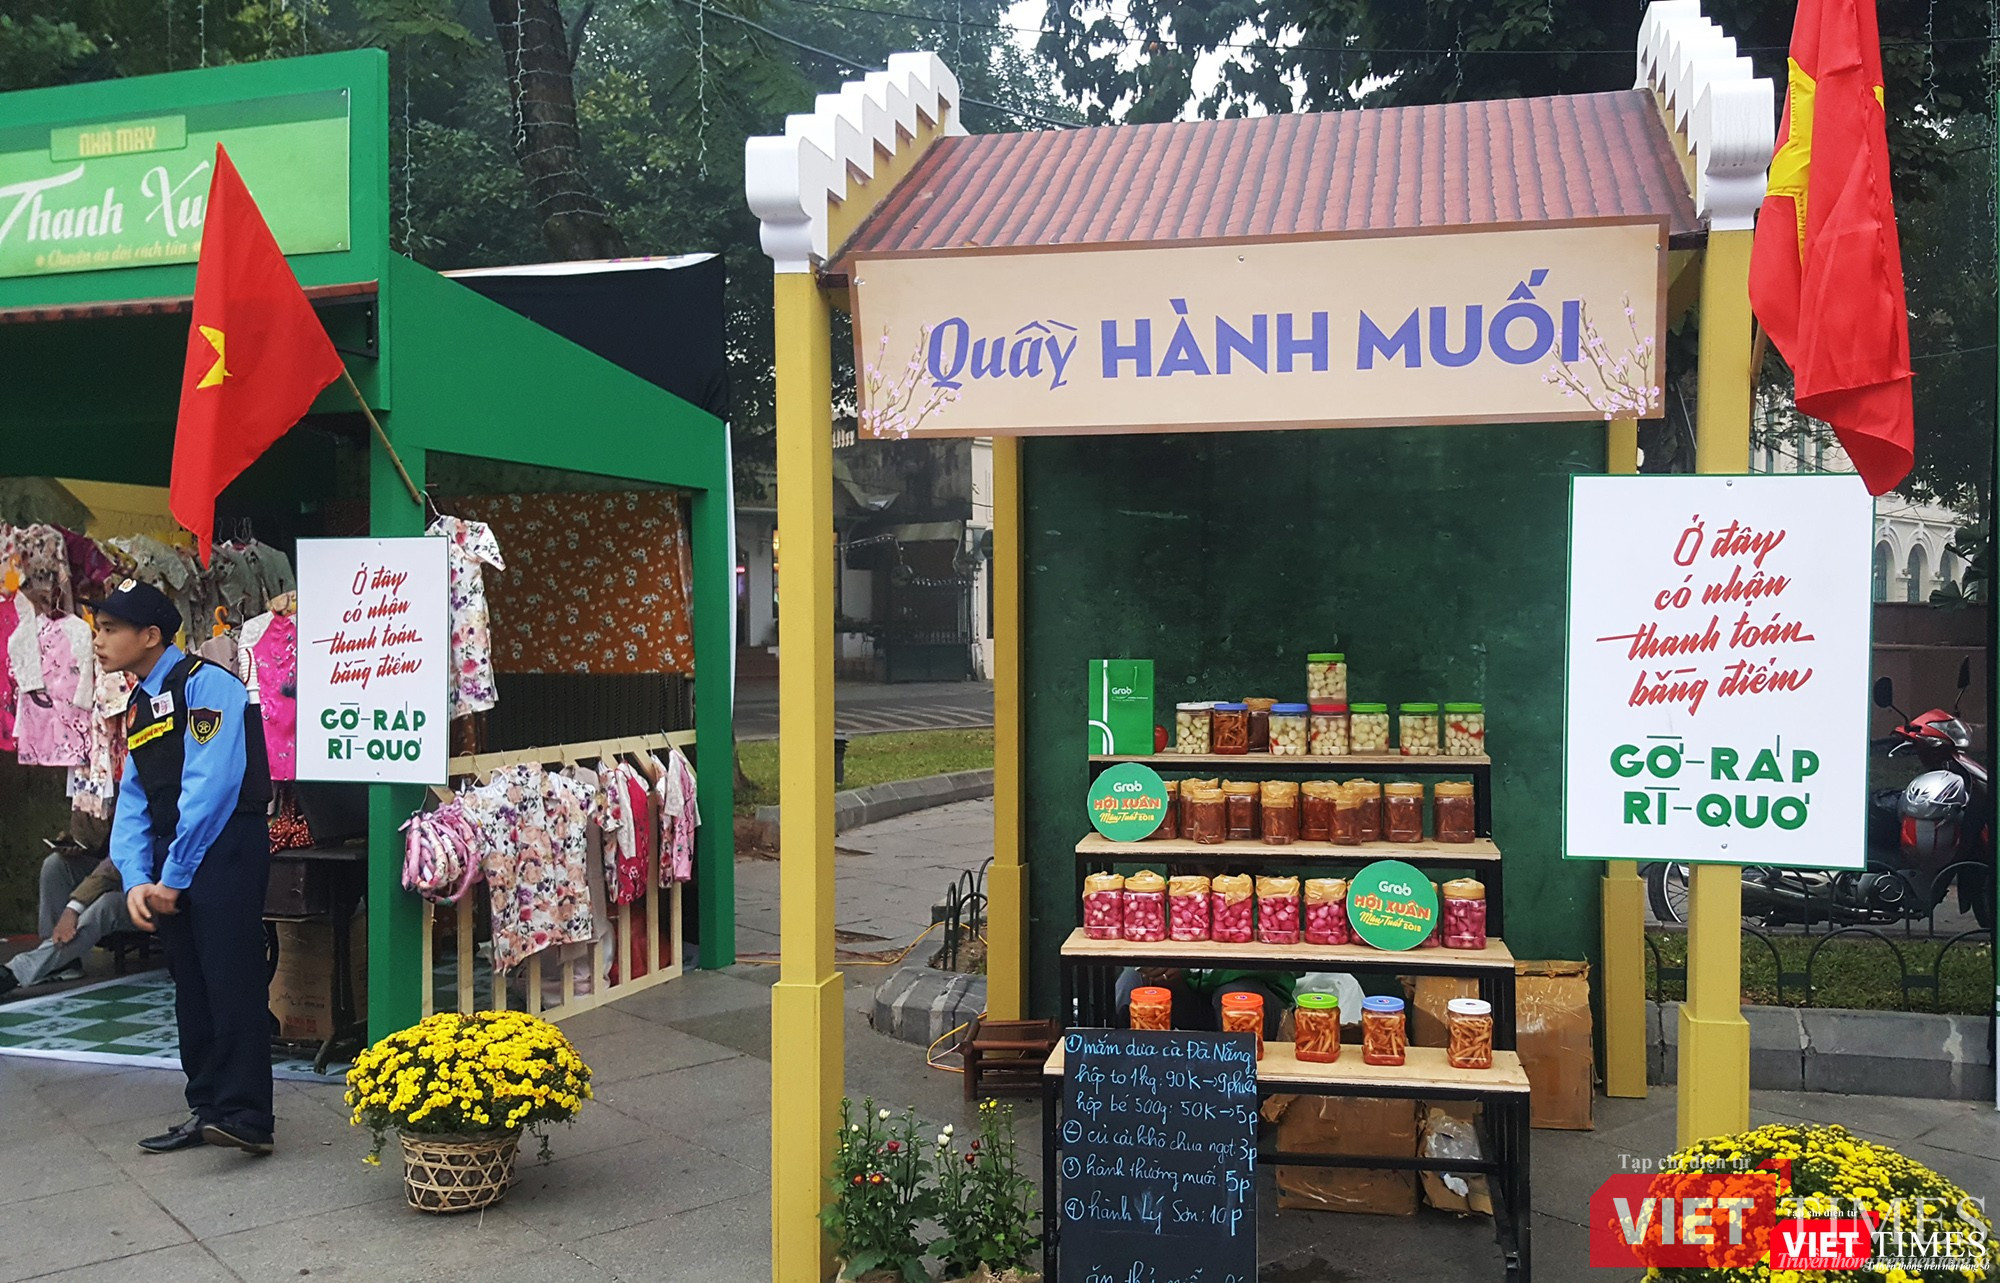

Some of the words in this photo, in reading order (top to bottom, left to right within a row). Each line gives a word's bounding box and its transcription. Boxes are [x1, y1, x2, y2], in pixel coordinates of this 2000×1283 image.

[0, 163, 124, 245] Thanh
[141, 160, 209, 237] Xu
[928, 317, 1078, 391] Quầy
[1101, 298, 1329, 378] HÀNH
[1357, 269, 1580, 370] MUỐI
[1673, 514, 1704, 567] Ở
[1711, 520, 1786, 569] đây
[352, 562, 368, 596] Ở
[371, 566, 408, 596] đây
[1654, 574, 1694, 611] có
[1701, 564, 1791, 607] nhận
[343, 600, 363, 624] có
[367, 594, 411, 621] nhận
[312, 626, 376, 655] thanh
[381, 624, 423, 648] toán
[1596, 615, 1720, 660] thanh
[1729, 611, 1815, 648] toán
[330, 659, 371, 690] bằng
[376, 652, 422, 678] điểm
[1628, 667, 1709, 716] bằng
[1718, 657, 1813, 697] điểm
[1111, 686, 1132, 695] Grab
[1113, 780, 1143, 792] Grab
[1094, 795, 1119, 813] HỘI
[1121, 794, 1161, 811] XUÂN
[1138, 813, 1155, 821] 2018
[1378, 881, 1412, 896] Grab
[1354, 893, 1383, 913] HỘI
[1385, 900, 1431, 921] XUÂN
[1403, 923, 1422, 933] 2018
[1084, 1034, 1121, 1055] mắm
[1162, 1040, 1184, 1057] cà
[1187, 1041, 1210, 1059] Đà
[1213, 1040, 1251, 1075] Nẵng
[1075, 1063, 1105, 1095] hộp
[1110, 1069, 1126, 1084] to
[1076, 1091, 1102, 1121] hộp
[1111, 1094, 1129, 1112] bé
[1137, 1125, 1167, 1148] khô
[1170, 1131, 1202, 1152] chua
[1086, 1153, 1125, 1176] hành
[1088, 1190, 1132, 1221] hành
[1141, 1195, 1165, 1235] Lý
